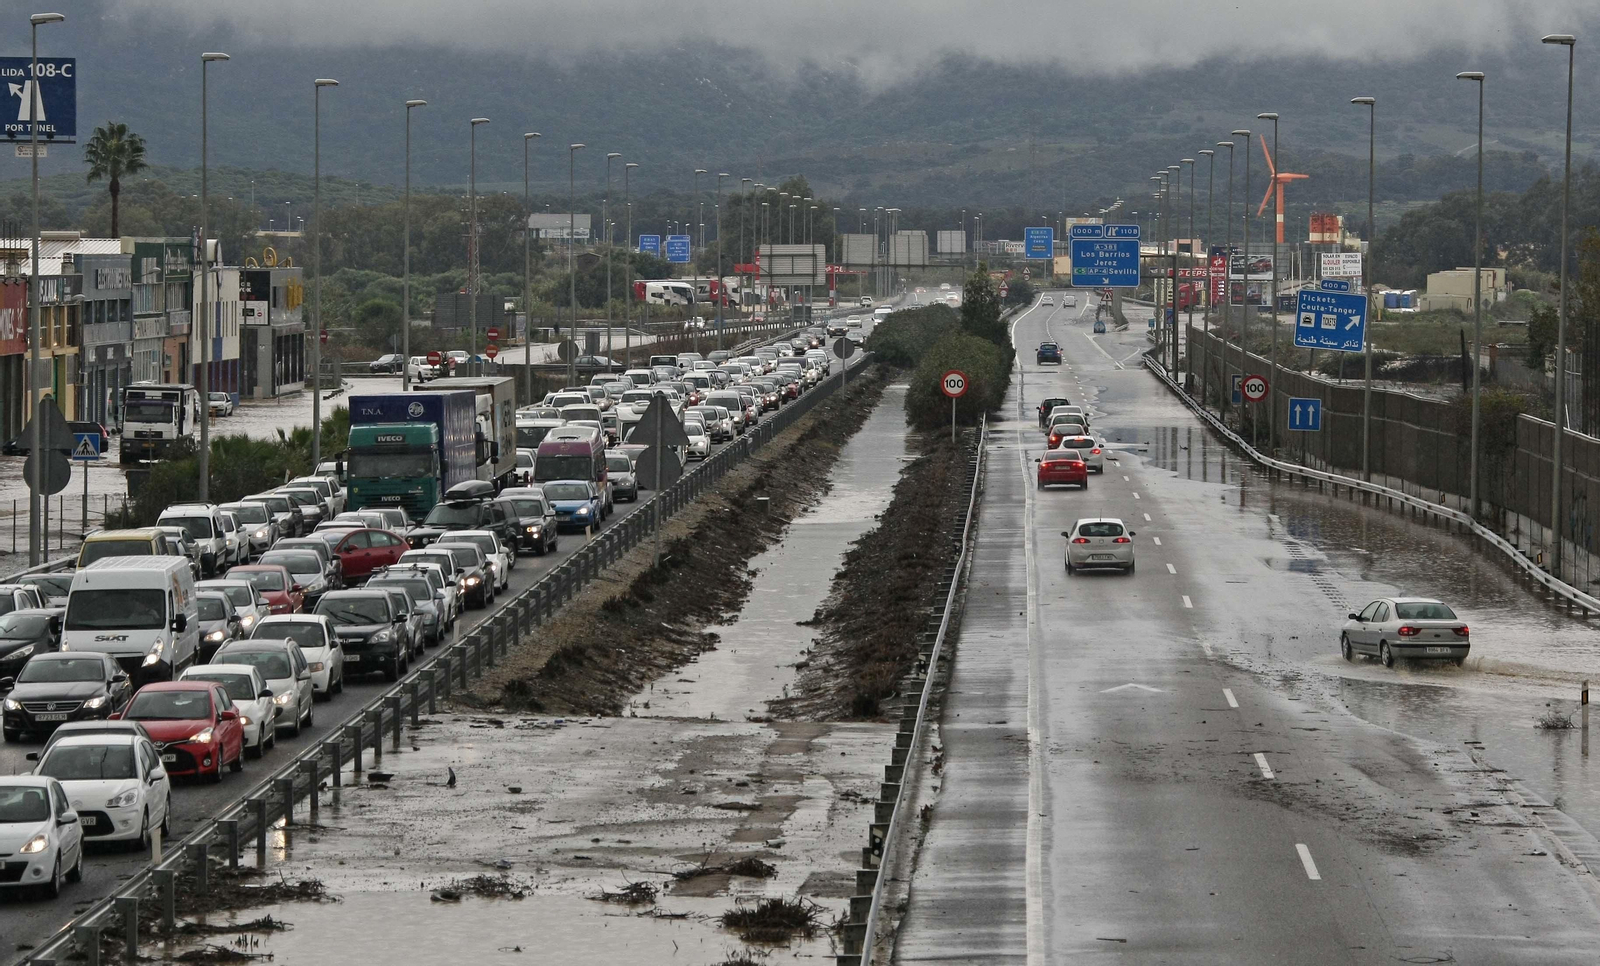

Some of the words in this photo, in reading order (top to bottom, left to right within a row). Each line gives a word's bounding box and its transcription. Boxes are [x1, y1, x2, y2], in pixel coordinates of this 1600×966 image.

[28, 63, 72, 77] 108-C
[1302, 295, 1336, 303] Tickets
[1301, 303, 1356, 314] Ceuta-Tanger
[1297, 334, 1316, 344] طنجة
[1341, 339, 1359, 348] تذاكر
[945, 379, 964, 388] 100
[1246, 384, 1264, 392] 100
